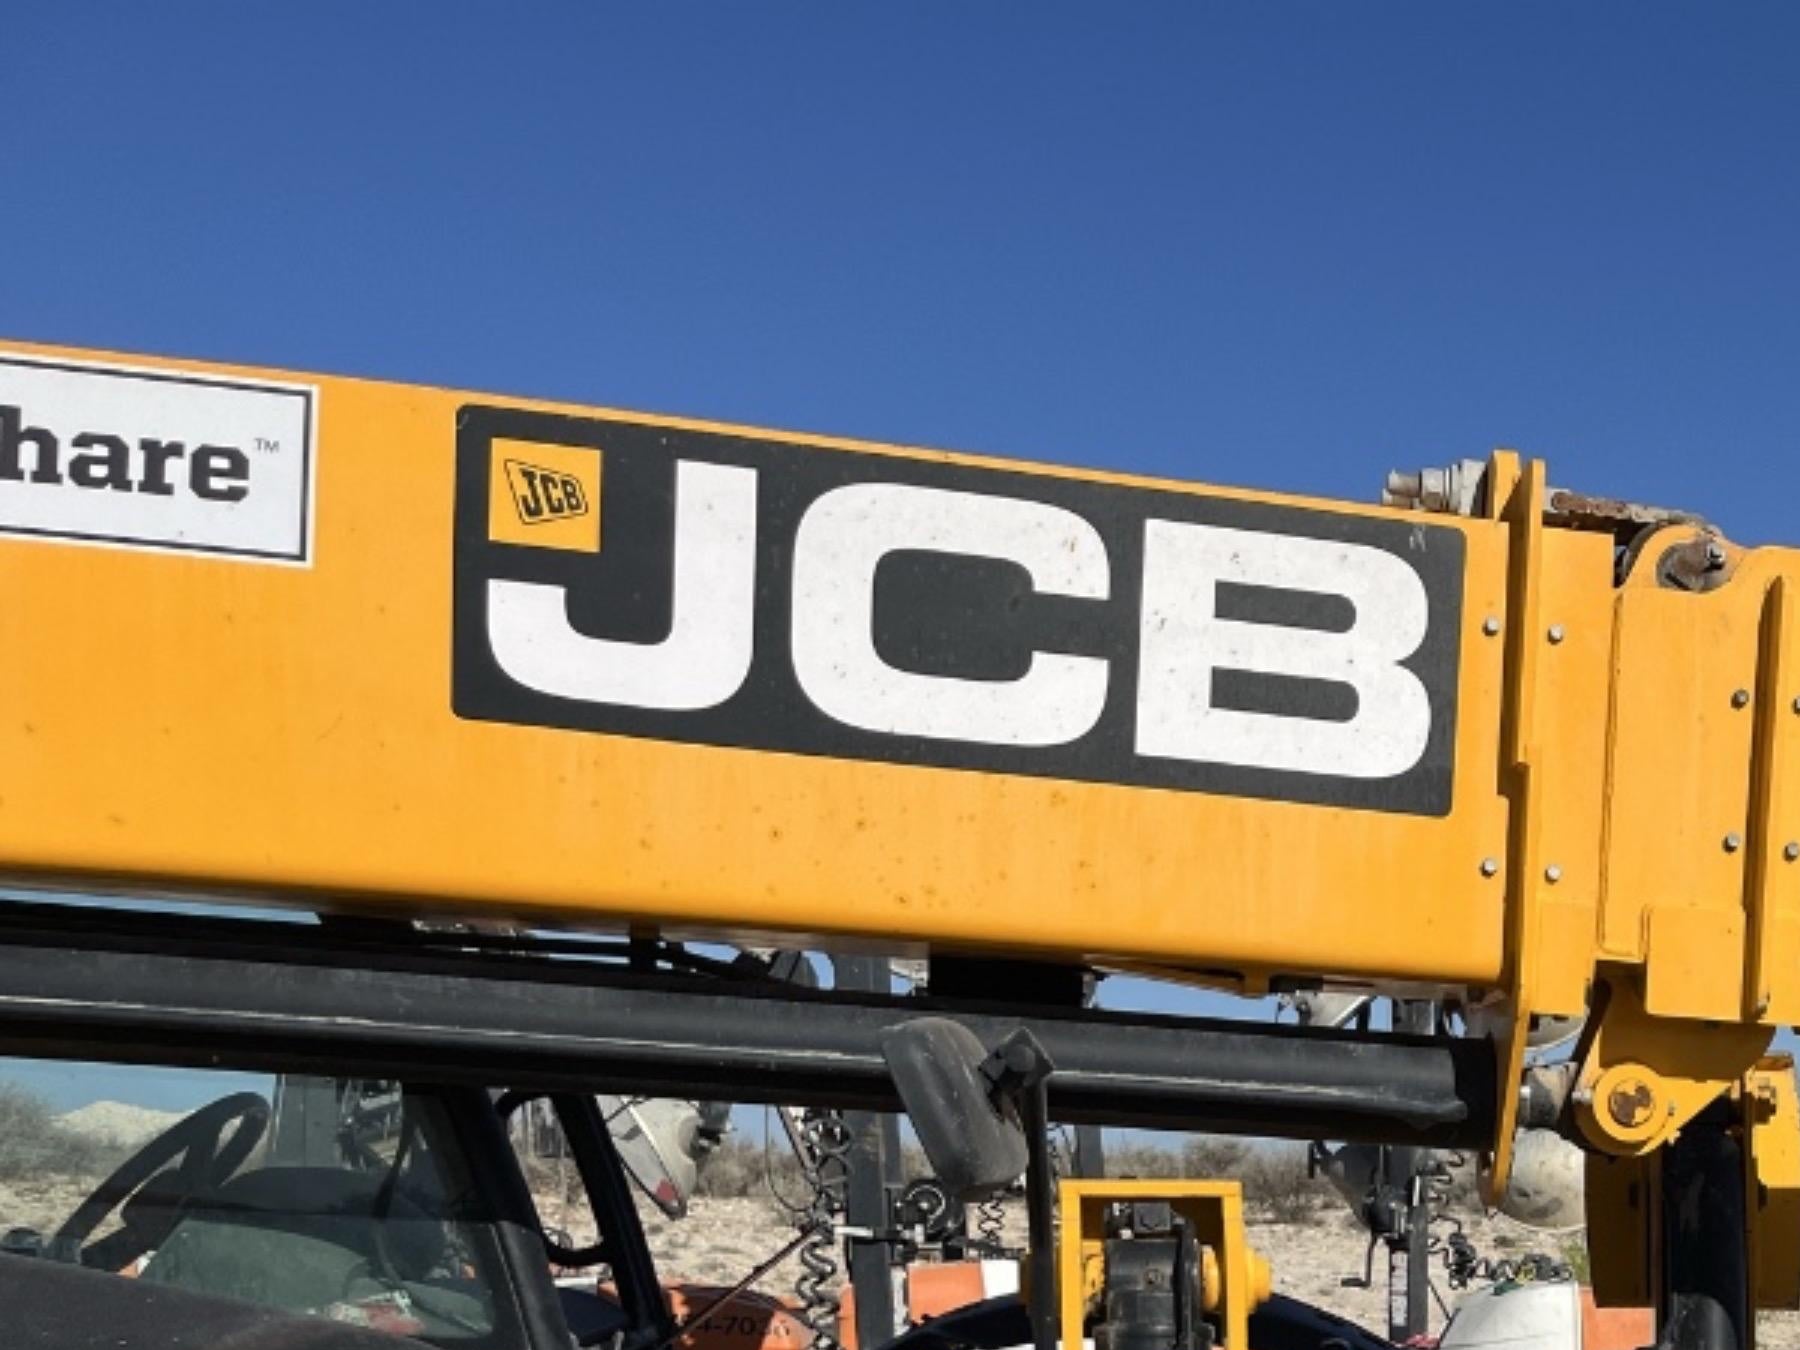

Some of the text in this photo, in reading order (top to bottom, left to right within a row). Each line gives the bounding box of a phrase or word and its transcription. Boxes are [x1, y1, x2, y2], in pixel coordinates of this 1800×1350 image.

[0, 404, 249, 502] hare
[519, 466, 582, 517] JCB
[487, 458, 1431, 779] JCB
